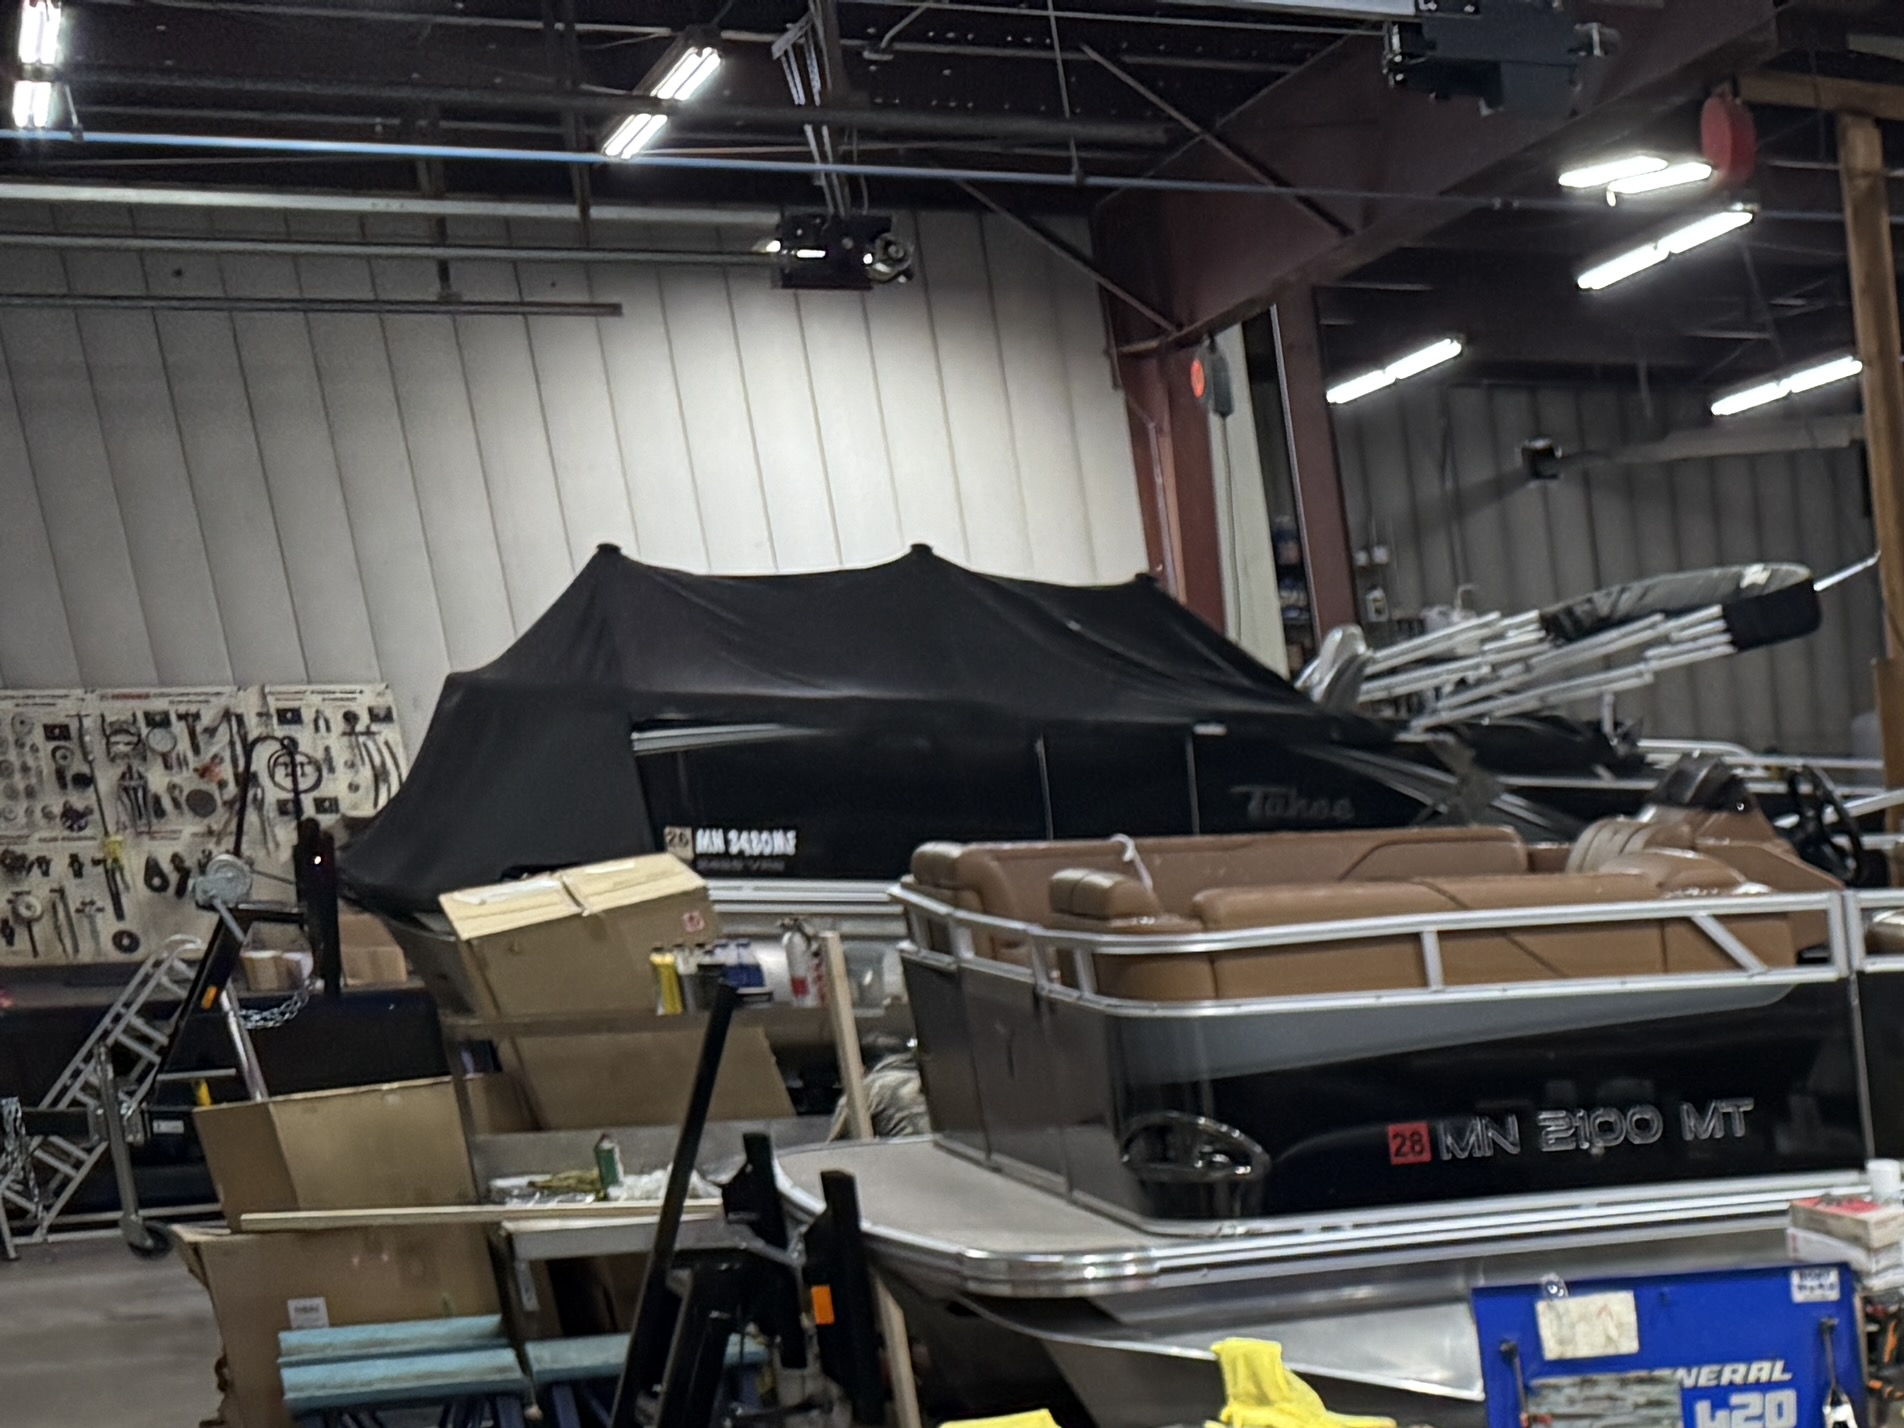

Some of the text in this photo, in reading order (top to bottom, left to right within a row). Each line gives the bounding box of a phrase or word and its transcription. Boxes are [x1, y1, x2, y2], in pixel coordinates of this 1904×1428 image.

[1391, 1130, 1425, 1158] 28
[1438, 1113, 1521, 1160] MN
[1680, 1098, 1754, 1141] MT
[1652, 1359, 1793, 1389] NERAL
